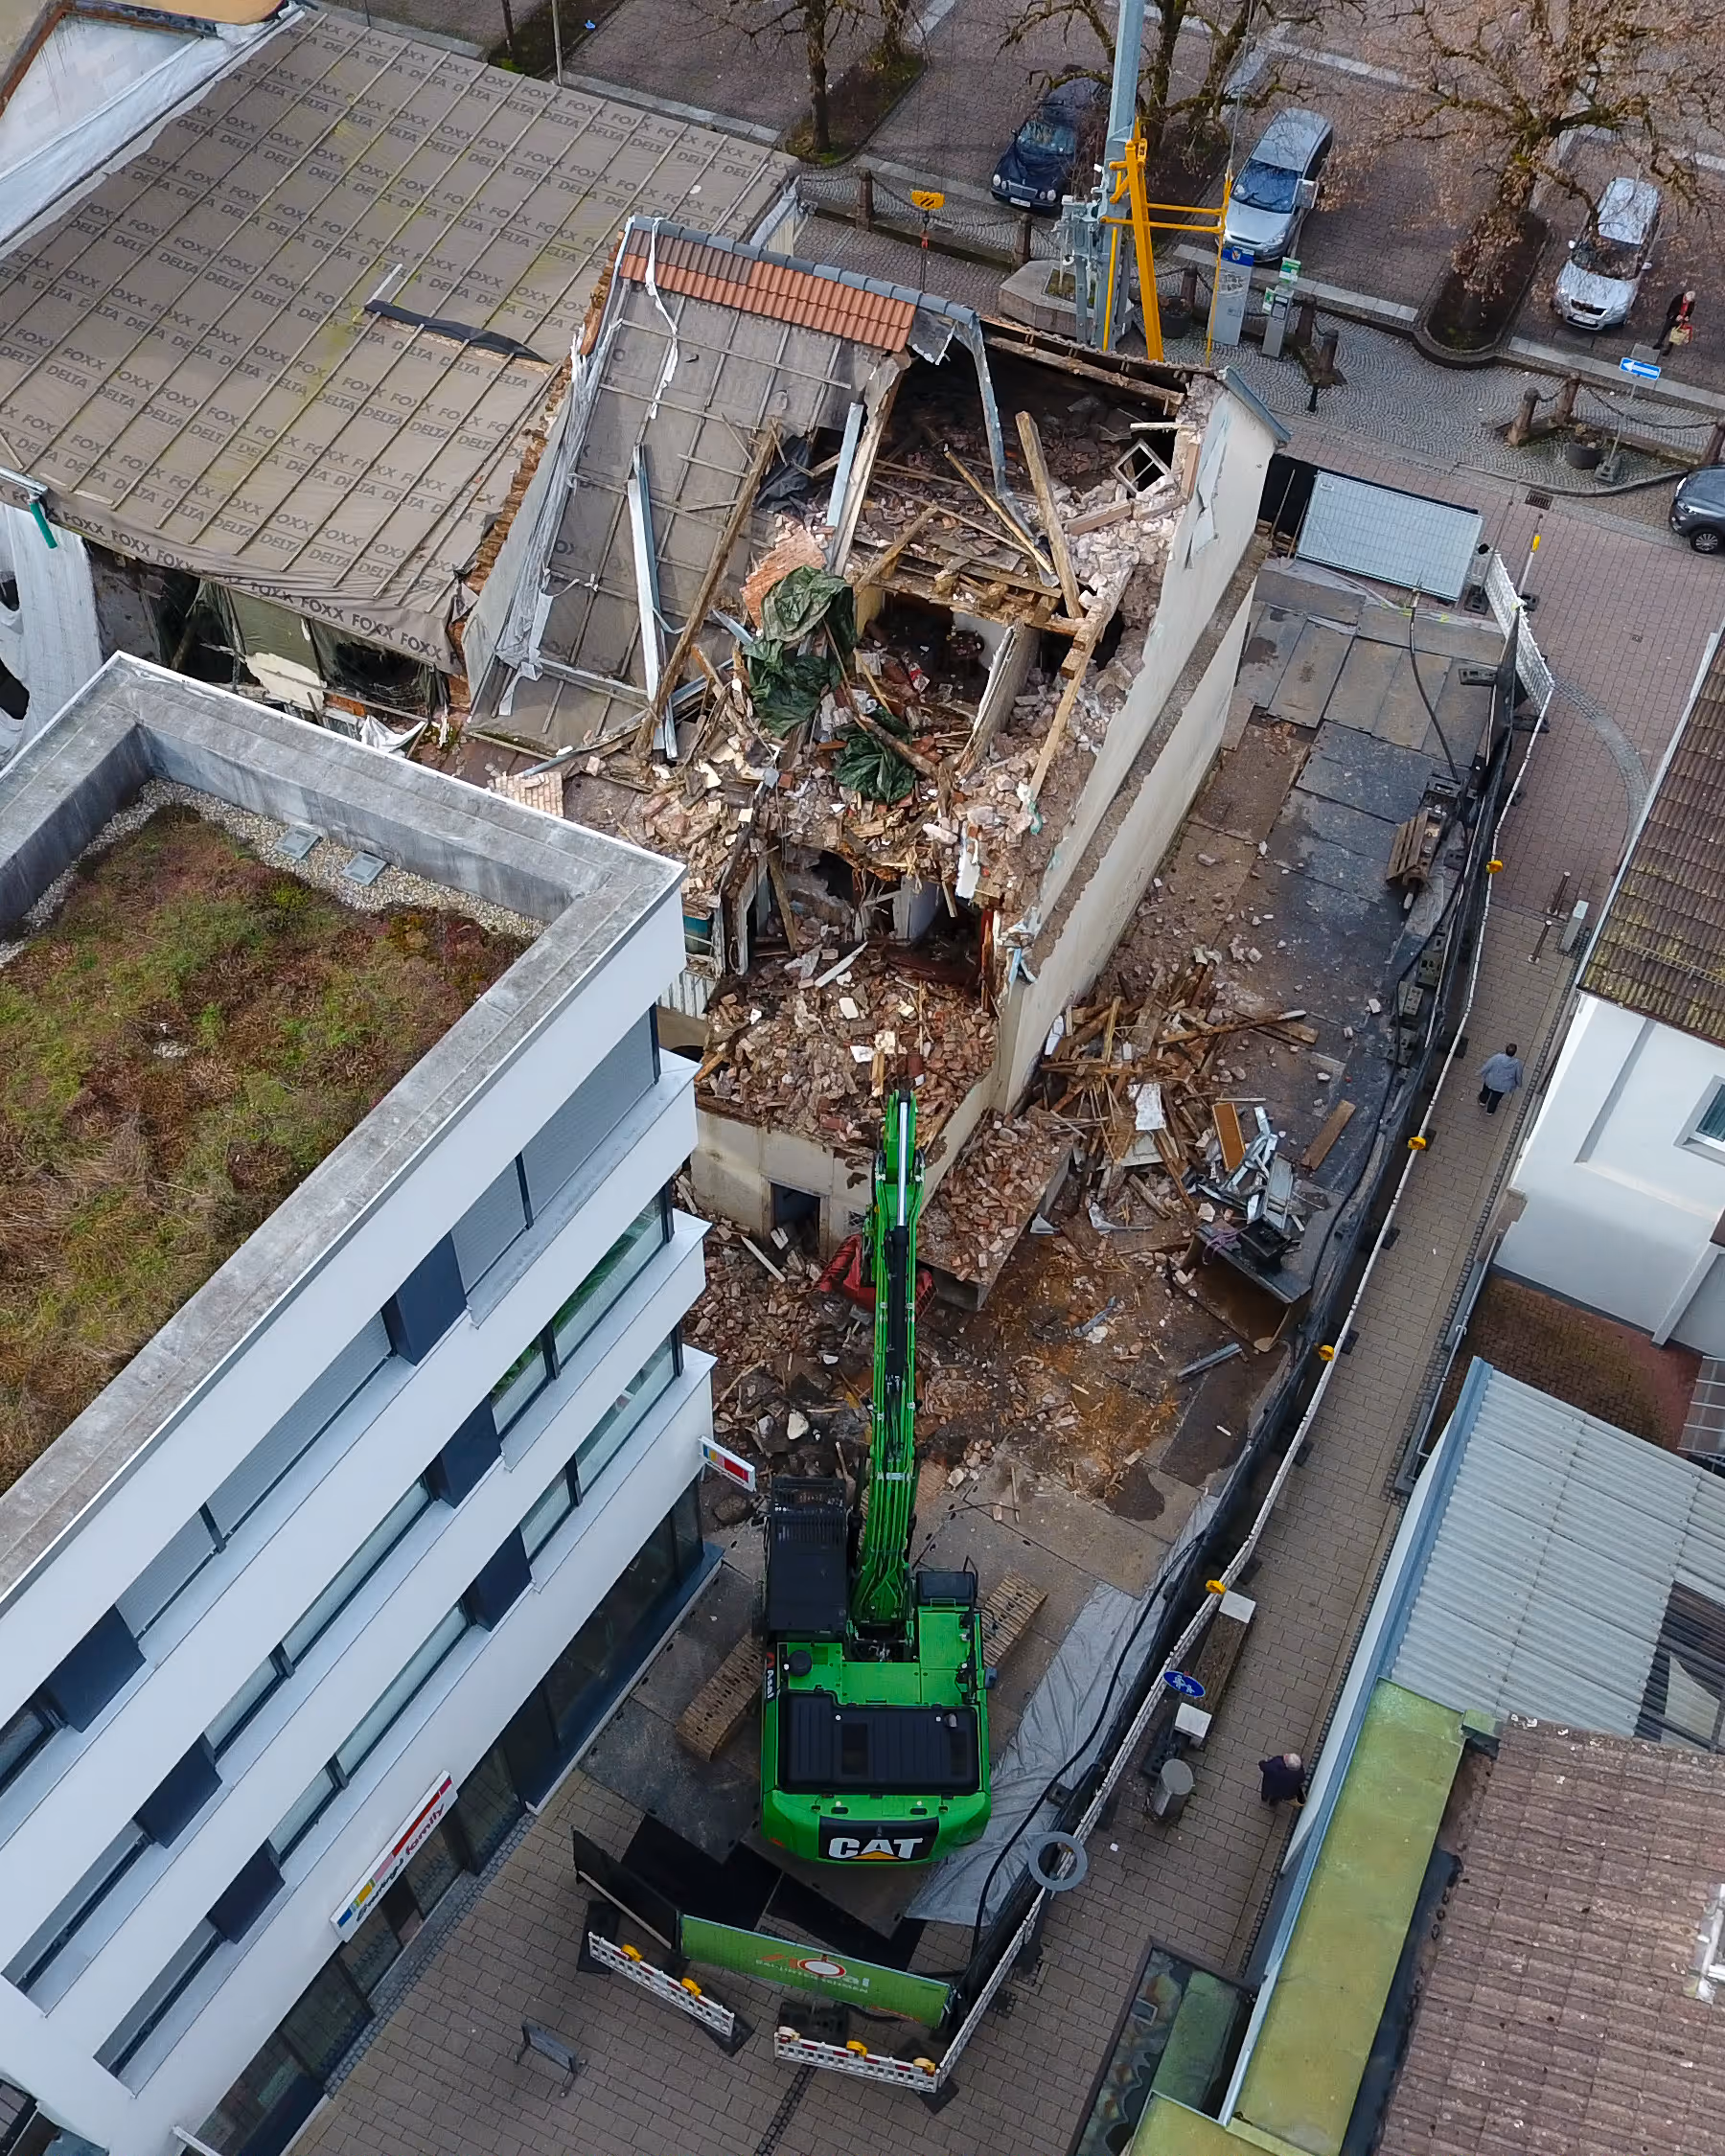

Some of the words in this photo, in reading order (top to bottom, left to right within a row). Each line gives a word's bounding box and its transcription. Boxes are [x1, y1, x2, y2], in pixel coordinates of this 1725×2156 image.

[157, 252, 201, 274] DELTA
[60, 346, 107, 371] FOXX
[45, 365, 91, 389] DELTA
[63, 512, 105, 537] FOXX
[111, 529, 150, 557] FOXX
[301, 597, 344, 622] FOXX
[352, 613, 395, 640] FOXX
[401, 632, 443, 660] FOXX
[828, 1837, 924, 1860] CAT
